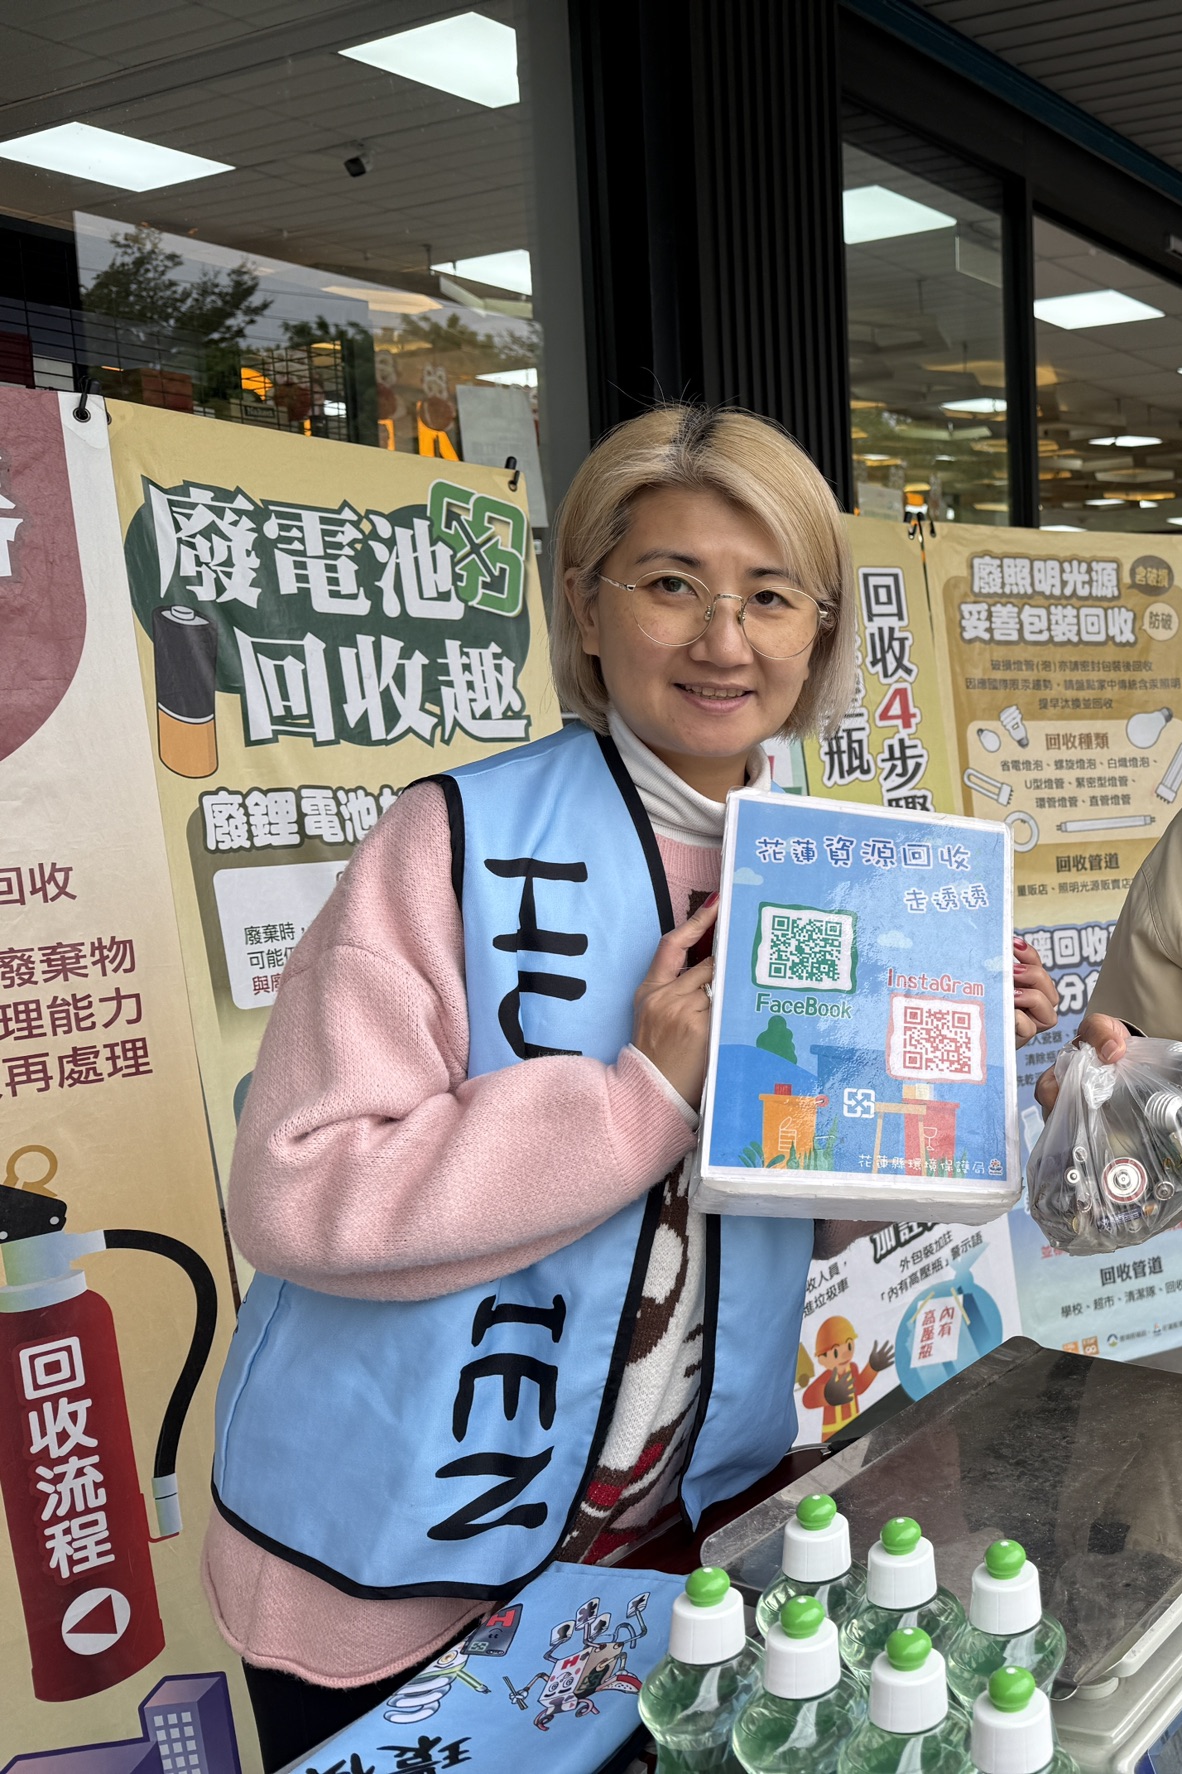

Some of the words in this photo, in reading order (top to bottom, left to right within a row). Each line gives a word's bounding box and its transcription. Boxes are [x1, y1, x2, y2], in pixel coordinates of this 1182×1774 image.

[150, 484, 466, 620] 廢電池
[972, 555, 1119, 598] 廢照明光源
[960, 602, 1137, 643] 妥善包裝回收
[237, 631, 530, 744] 回收趣
[1045, 732, 1110, 751] 回收種類
[202, 787, 404, 851] 廢鋰電池
[756, 836, 971, 873] 花蓮資源回收
[1056, 852, 1120, 873] 回收管道
[904, 883, 989, 914] 走透透
[887, 967, 985, 998] InstaGram
[755, 992, 852, 1020] FaceBook
[858, 1153, 985, 1174] 花蓮縣環境保護局
[1100, 1255, 1163, 1287] 回收管道
[19, 1336, 115, 1580] 回收流程
